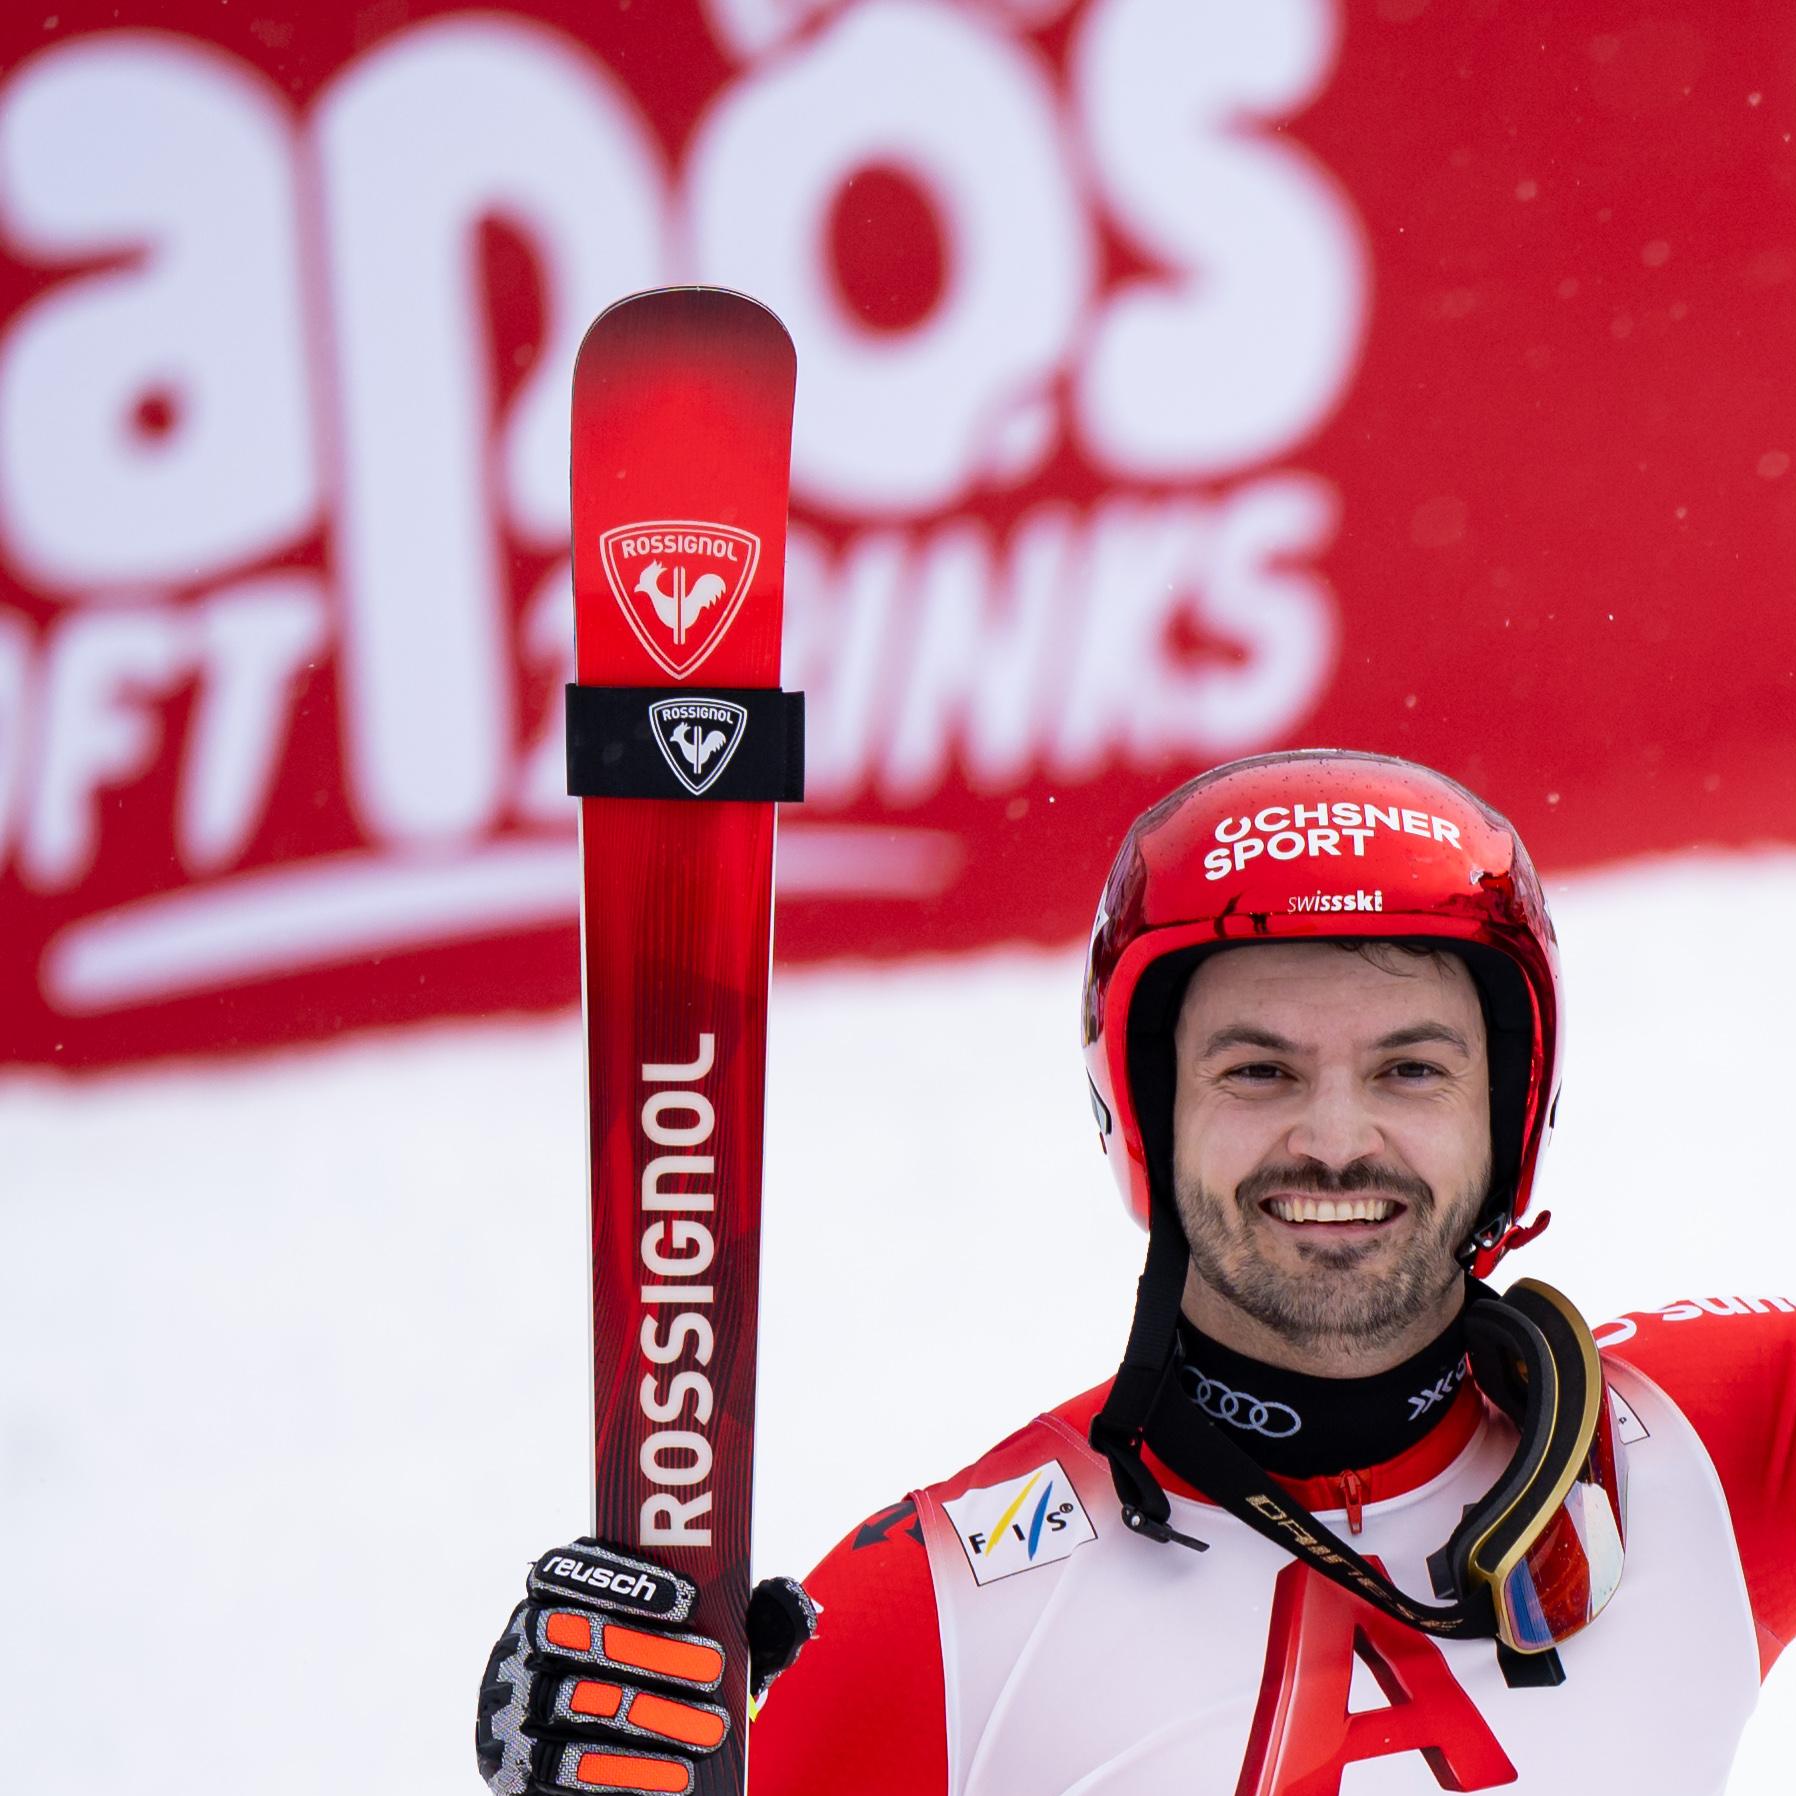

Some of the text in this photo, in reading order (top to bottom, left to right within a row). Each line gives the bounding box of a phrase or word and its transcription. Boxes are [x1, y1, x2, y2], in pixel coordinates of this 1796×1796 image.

[621, 534, 738, 562] ROSSIGNOL
[662, 706, 734, 724] ROSSIGNOL
[1204, 827, 1375, 881] SPORT
[1287, 890, 1383, 913] swissski
[640, 1032, 715, 1547] ROSSIGNOL
[543, 1551, 659, 1602] reusch
